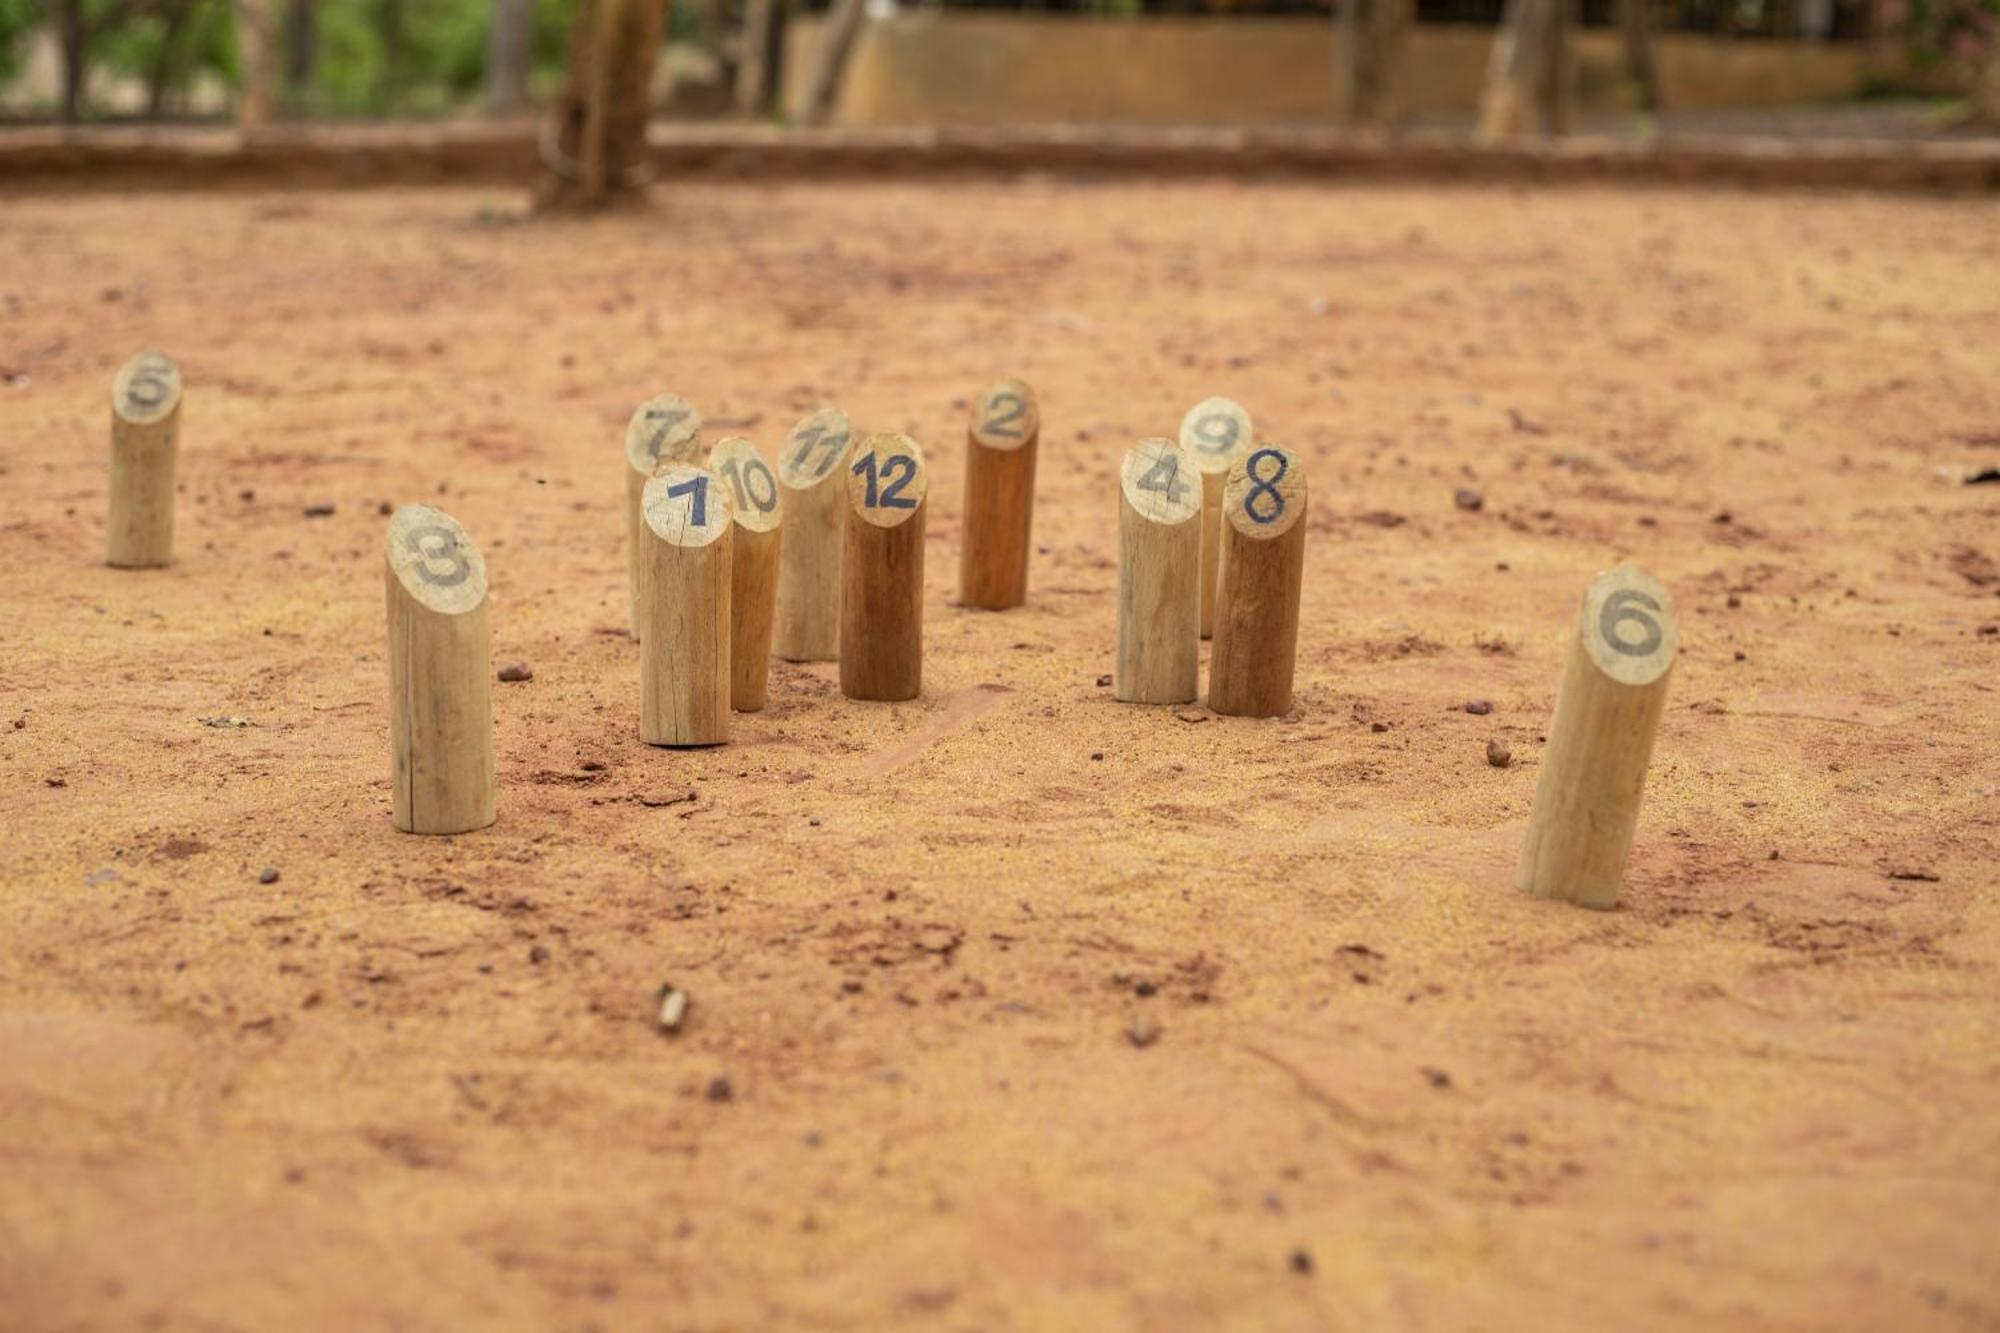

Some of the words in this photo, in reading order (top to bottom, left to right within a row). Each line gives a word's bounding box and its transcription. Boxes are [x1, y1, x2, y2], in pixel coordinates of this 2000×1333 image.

[127, 366, 171, 406] 5
[645, 411, 689, 457] 7
[983, 393, 1024, 437] 2
[1195, 413, 1238, 454] 9
[790, 427, 849, 477] 11
[667, 476, 707, 527] 1
[720, 457, 776, 512] 10
[852, 451, 916, 508] 12
[1137, 454, 1190, 503] 4
[1246, 449, 1288, 523] 8
[408, 526, 469, 586] 3
[1600, 589, 1661, 657] 6
